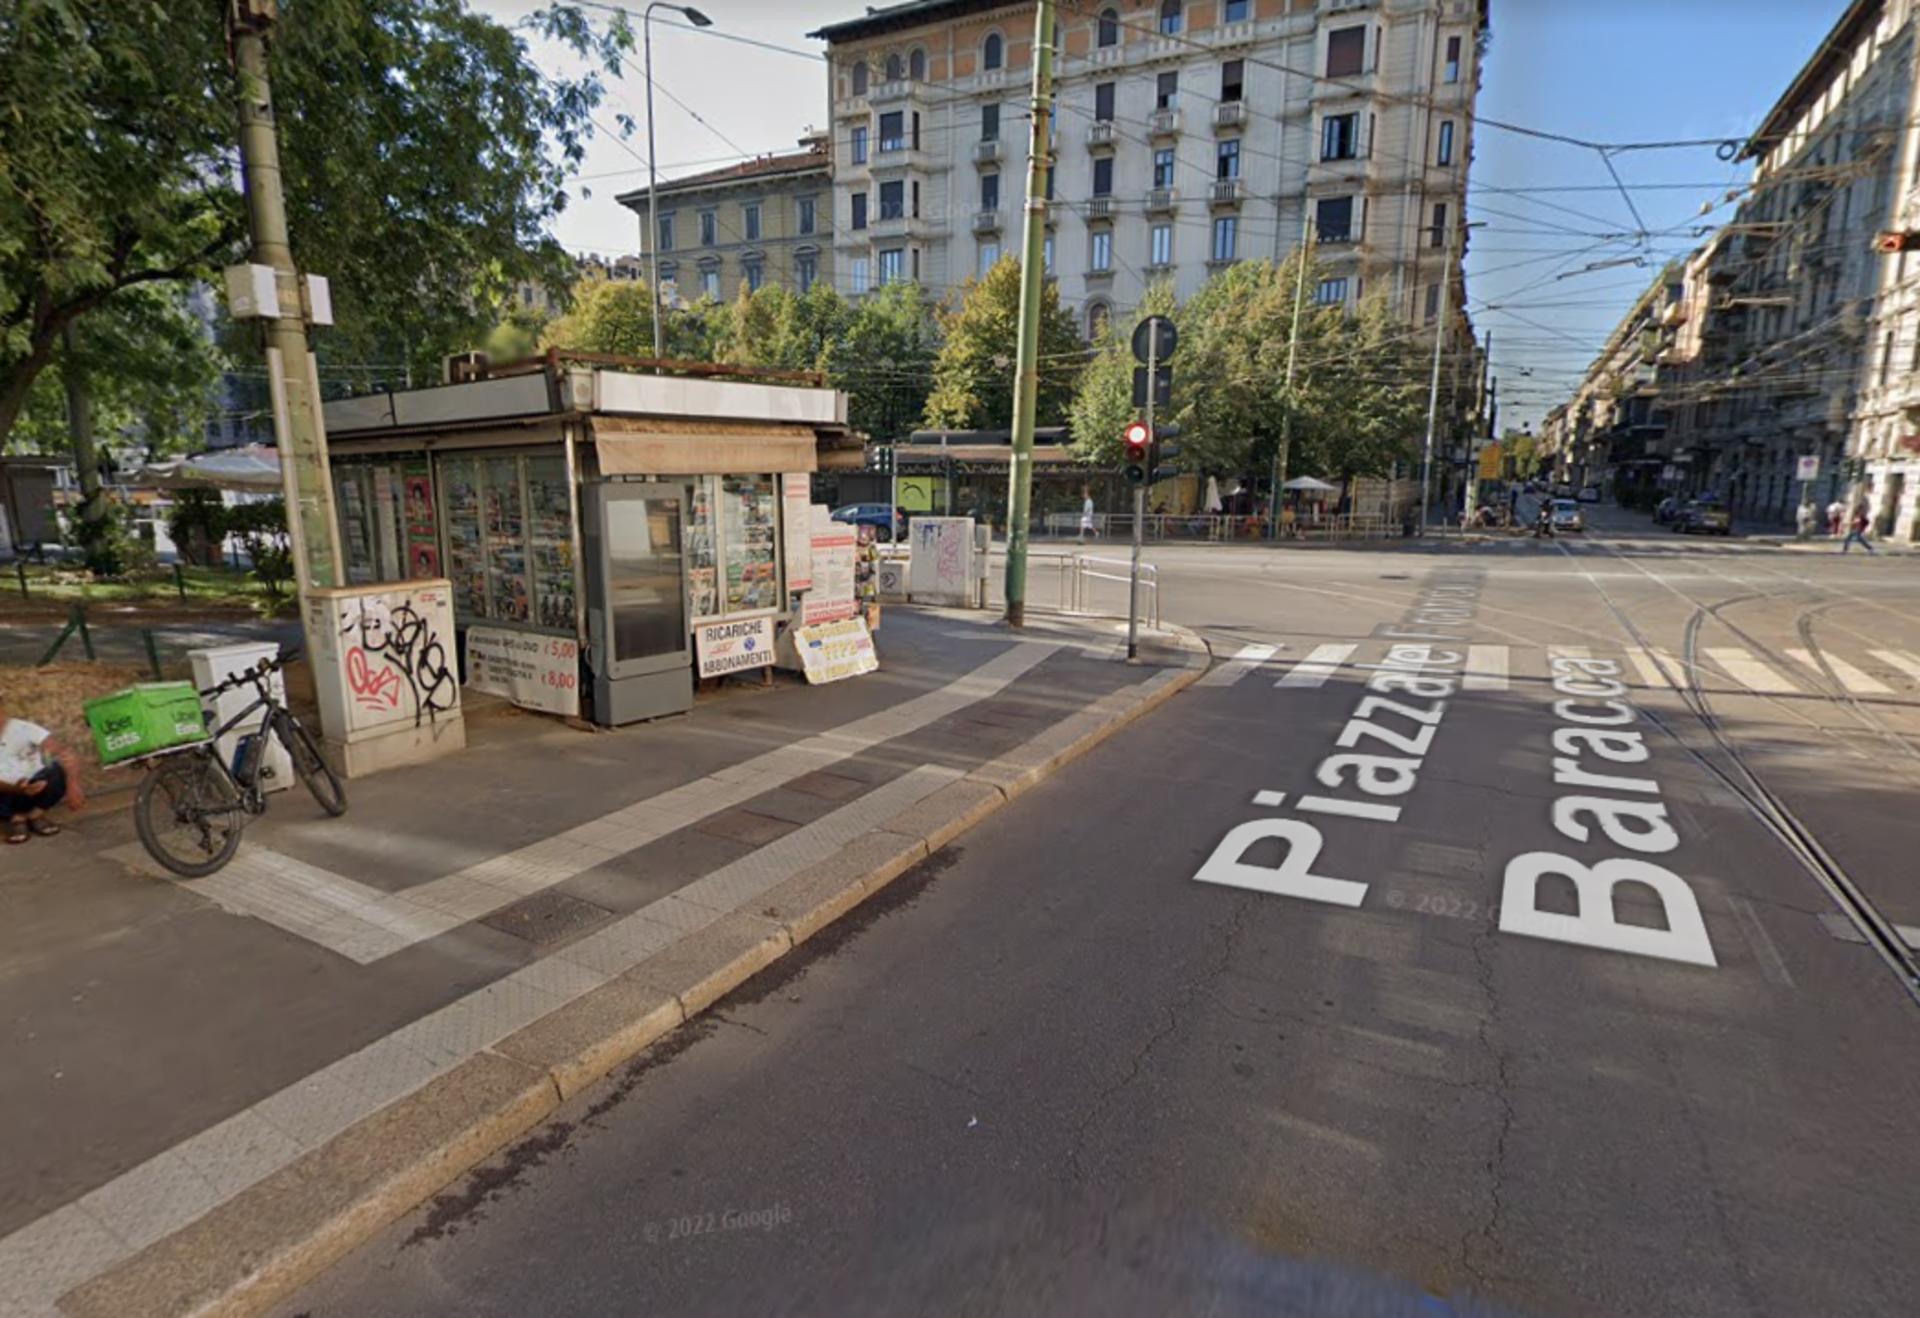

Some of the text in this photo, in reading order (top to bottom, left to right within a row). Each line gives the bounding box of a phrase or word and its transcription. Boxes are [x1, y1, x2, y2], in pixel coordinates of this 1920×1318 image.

[706, 619, 763, 642] RICARICHE
[551, 640, 576, 660] 5,00
[704, 650, 772, 674] ABBONAMENTI
[101, 716, 133, 735] Uber
[105, 731, 141, 752] Eats
